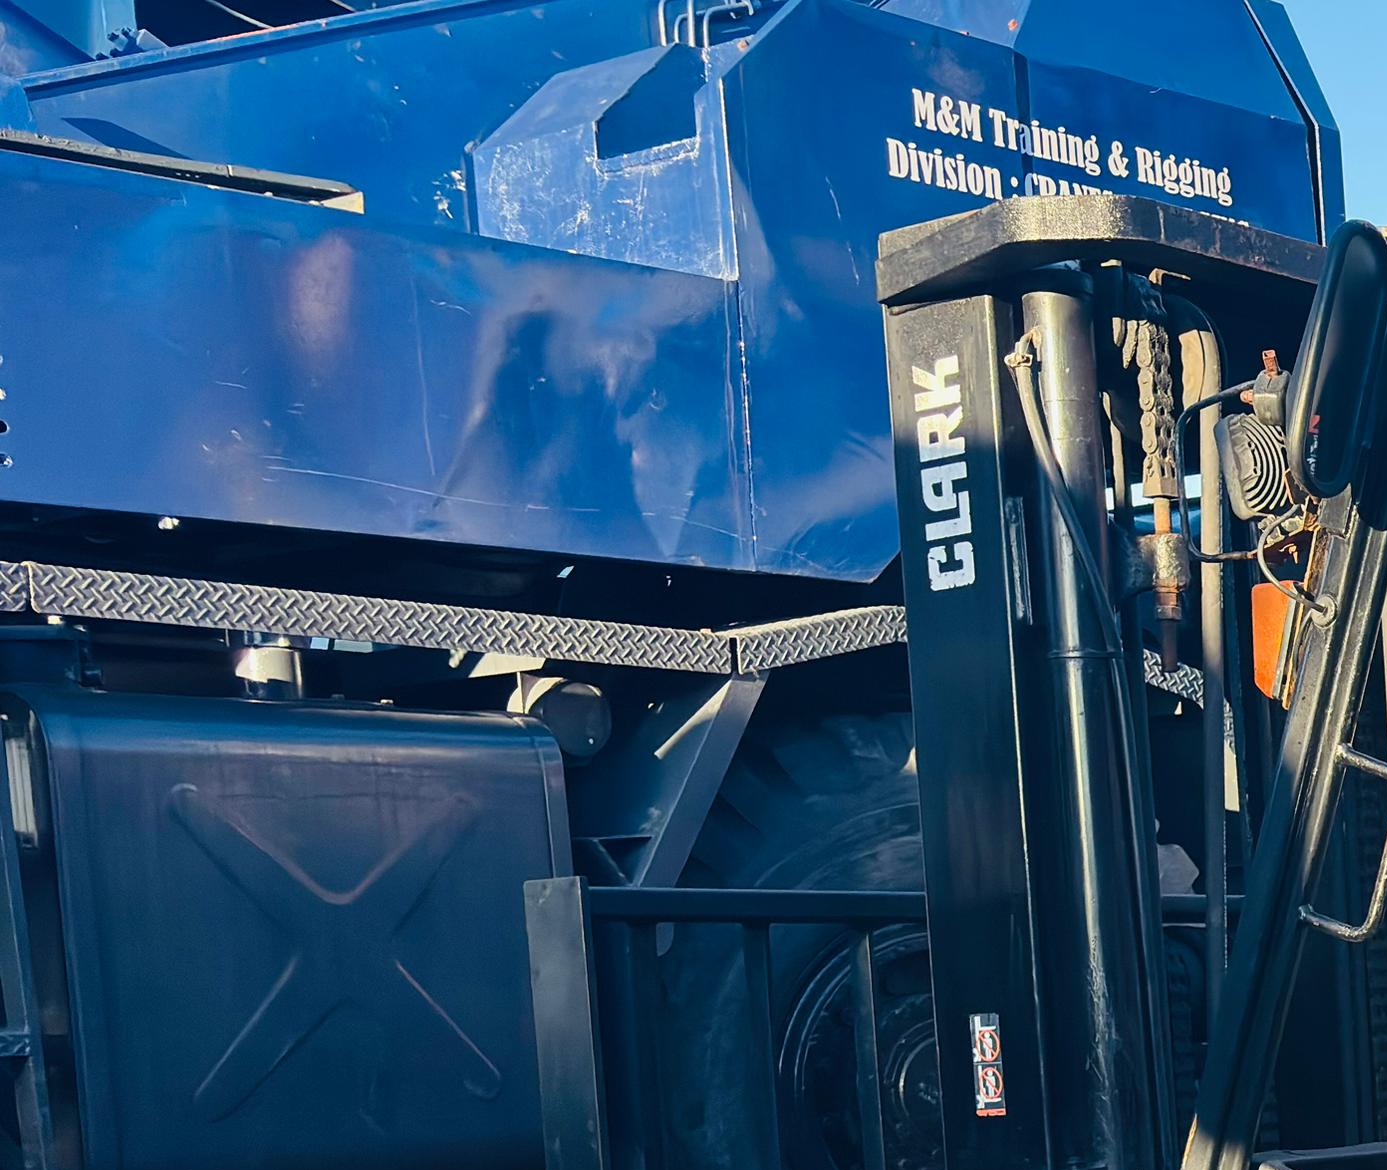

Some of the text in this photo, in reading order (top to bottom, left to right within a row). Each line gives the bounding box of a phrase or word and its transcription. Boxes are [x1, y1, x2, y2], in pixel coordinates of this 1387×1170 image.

[886, 137, 1004, 200] Division
[911, 88, 1233, 206] M&M Training & Rigging
[911, 355, 976, 592] CLARK
